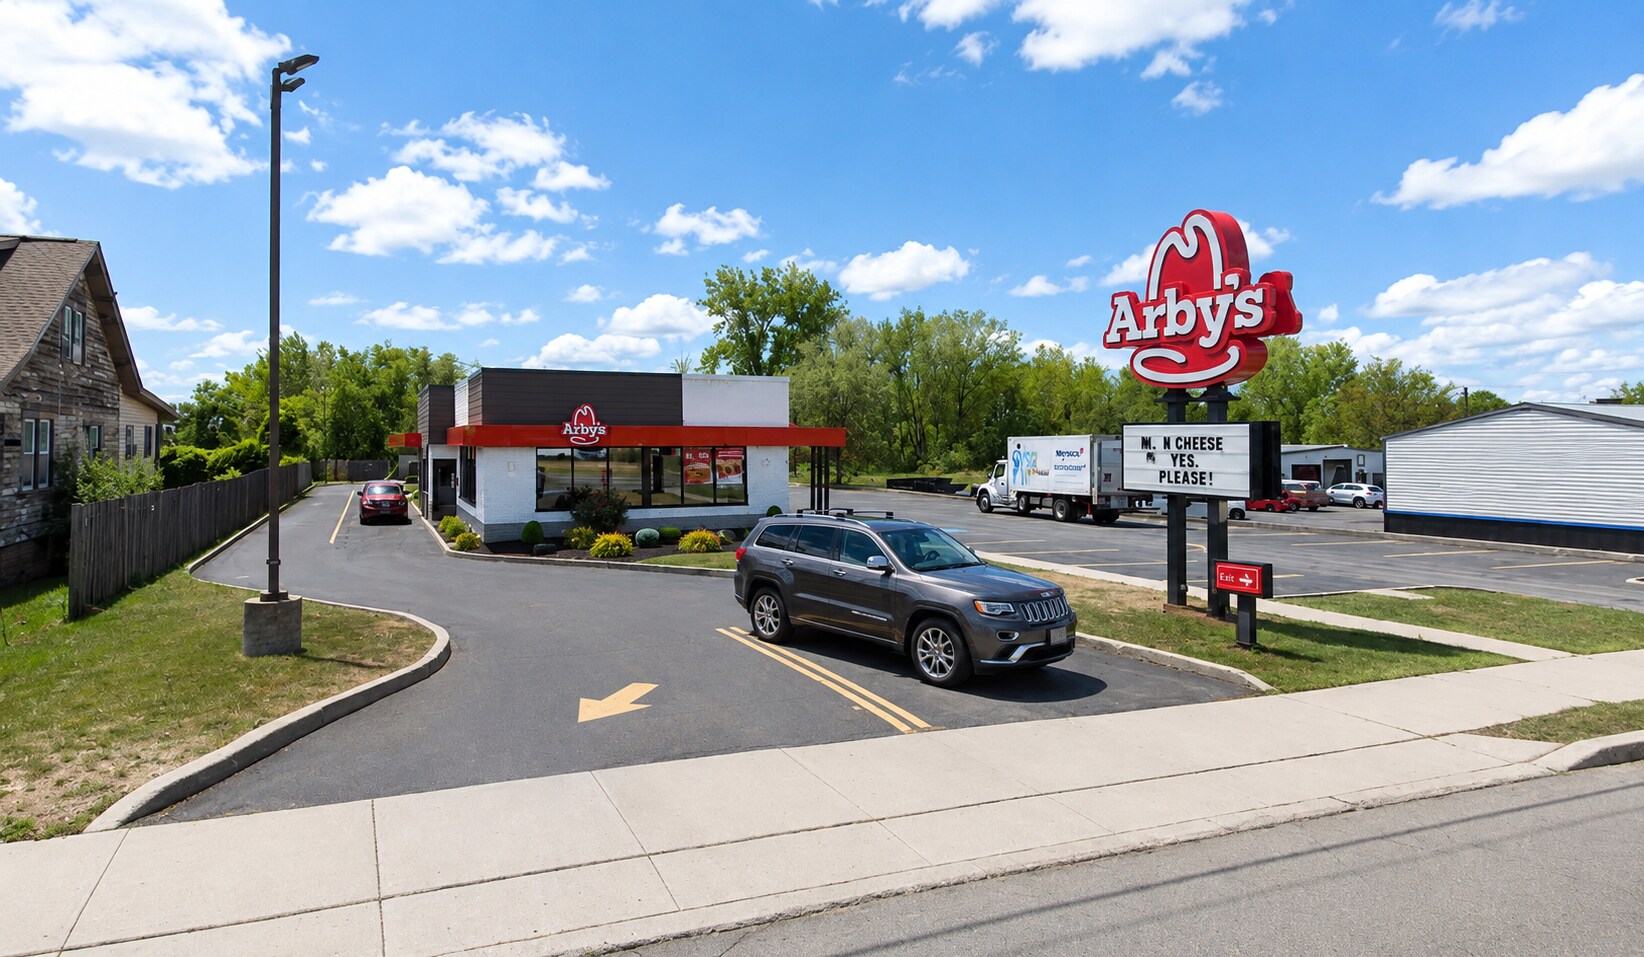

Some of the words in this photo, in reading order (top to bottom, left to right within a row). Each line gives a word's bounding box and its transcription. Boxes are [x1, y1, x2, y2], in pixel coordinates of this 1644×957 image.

[1106, 273, 1264, 348] Arby's
[562, 421, 606, 438] Arby's
[1175, 436, 1223, 451] CHEESE
[1170, 453, 1199, 468] YES.
[1159, 470, 1213, 486] PLEASE!
